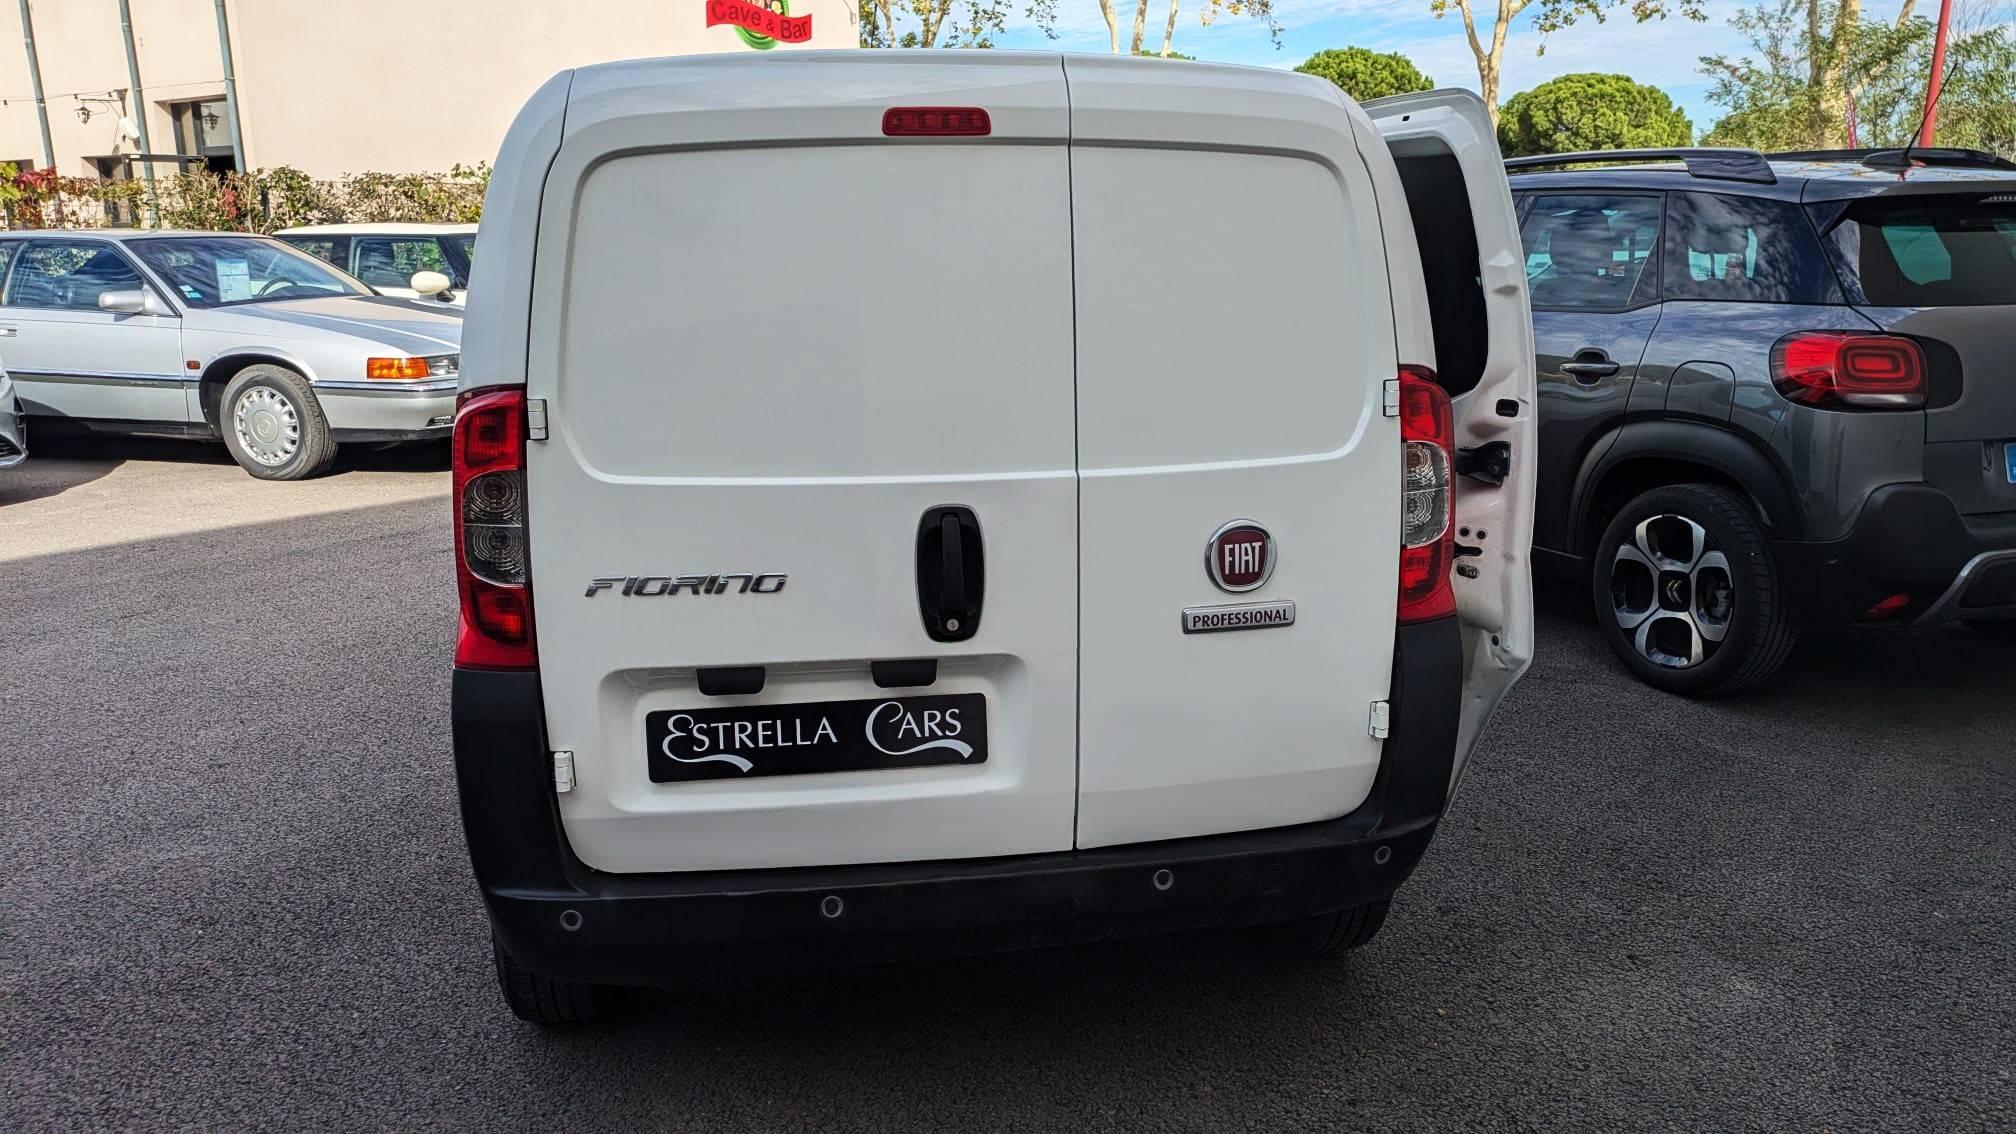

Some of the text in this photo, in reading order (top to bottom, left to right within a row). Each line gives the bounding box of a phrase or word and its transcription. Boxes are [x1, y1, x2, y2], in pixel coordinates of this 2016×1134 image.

[711, 1, 808, 39] Cave & Bar
[1224, 542, 1262, 575] FIAT
[584, 572, 788, 598] FIORINO
[1192, 608, 1289, 628] PROFESSIONAL
[662, 701, 973, 773] ESTRELLA CARS
